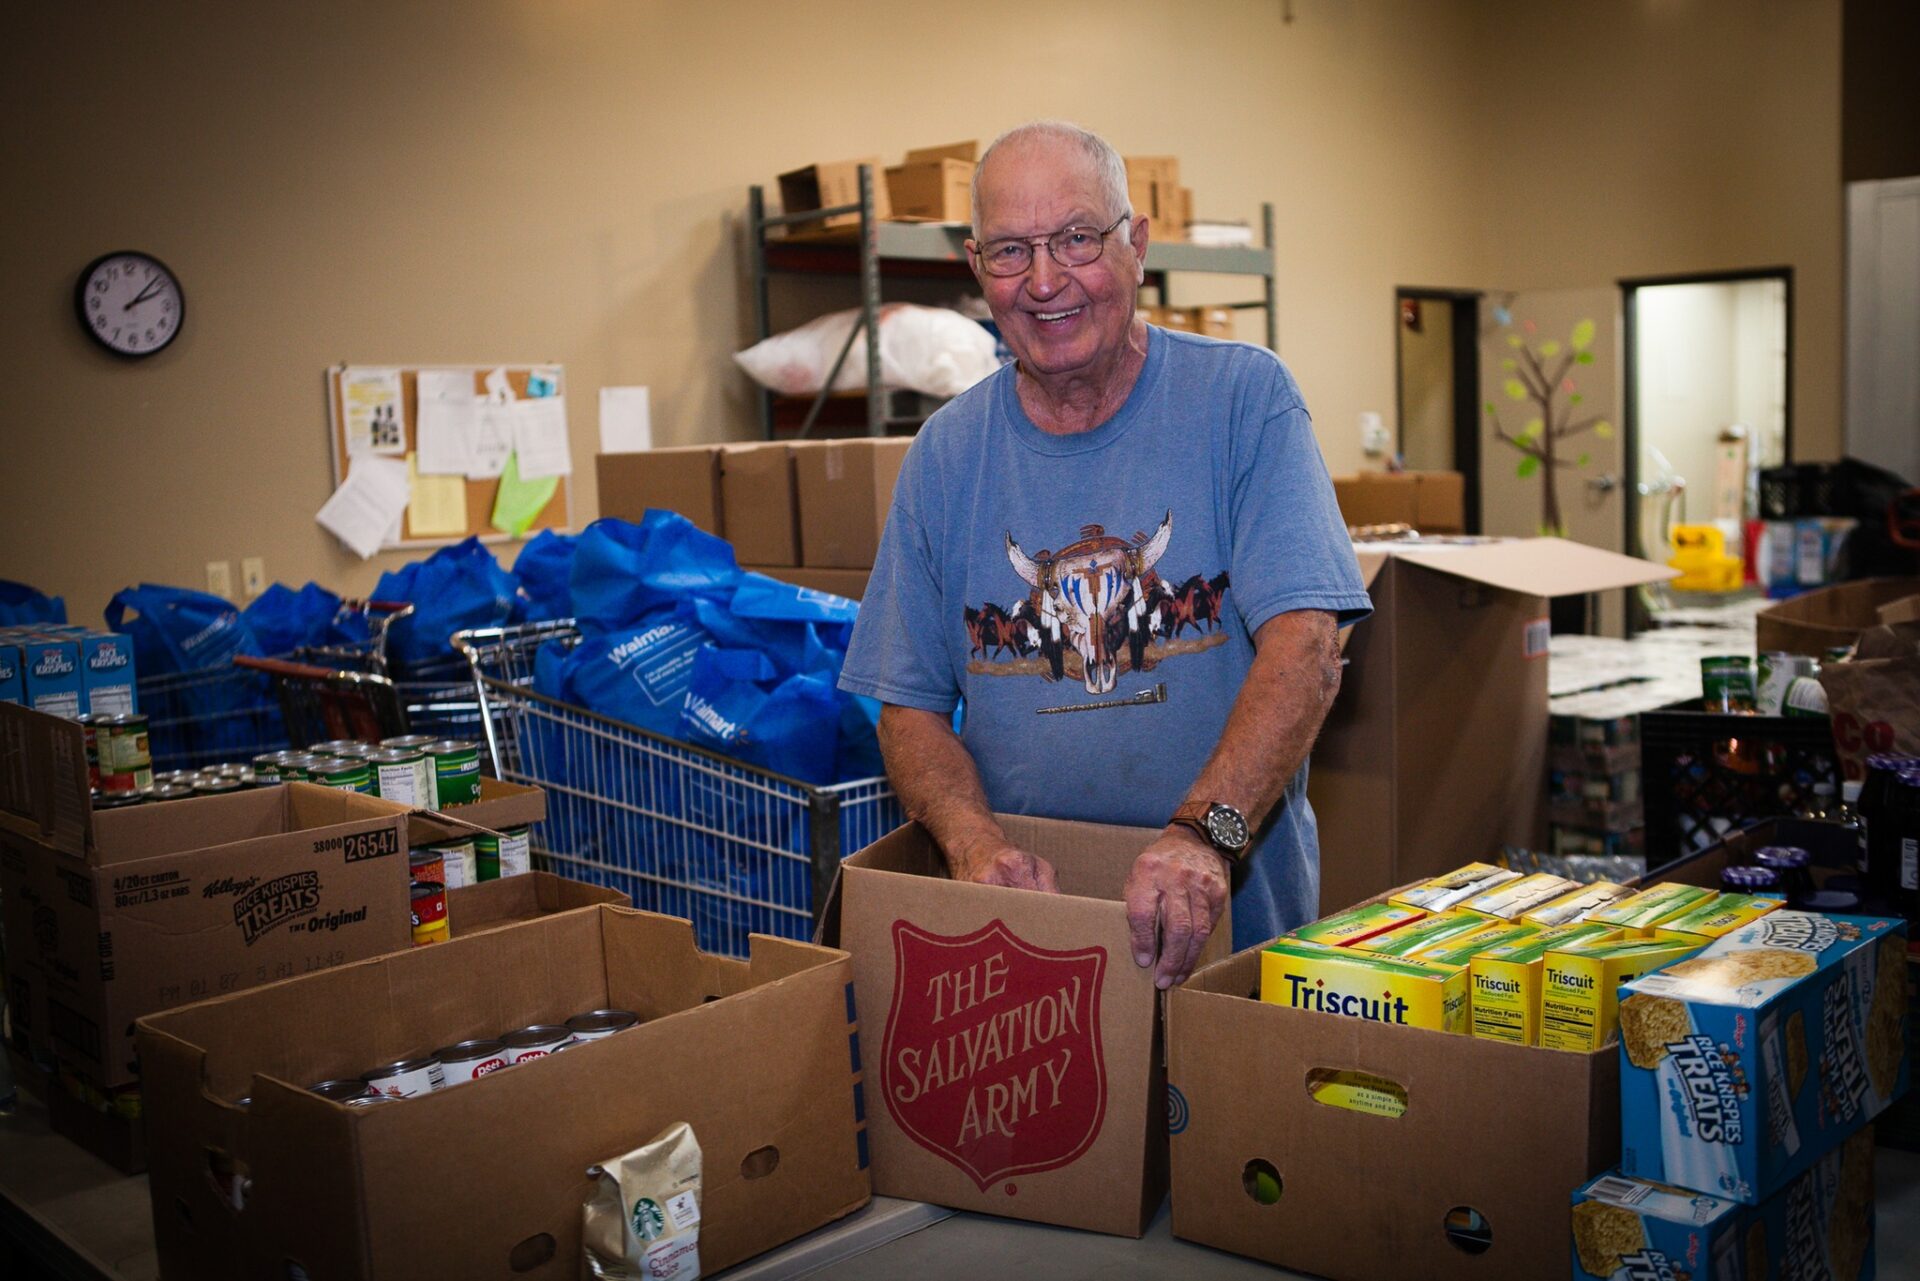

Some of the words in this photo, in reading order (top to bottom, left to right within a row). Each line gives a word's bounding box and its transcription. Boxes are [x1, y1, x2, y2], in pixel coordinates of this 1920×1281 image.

[44, 654, 62, 665] RICE
[98, 647, 117, 659] RICE
[608, 625, 675, 664] Walma
[35, 661, 74, 676] KRISPIES
[90, 655, 128, 669] KRISPIES
[684, 692, 736, 740] Walmart
[313, 838, 342, 853] 38000
[346, 830, 397, 861] 26547
[203, 877, 257, 898] Kellogg's
[235, 891, 261, 916] RICE
[260, 871, 318, 899] KRISPIES
[237, 887, 320, 946] TREATS
[308, 905, 367, 933] Original
[927, 952, 1010, 1024] THE
[1473, 974, 1520, 993] Triscuit
[1546, 968, 1594, 989] Triscuit
[1284, 974, 1408, 1025] Triscuit
[1474, 1007, 1503, 1016] Nutrition
[1504, 1011, 1522, 1019] Facts
[1545, 1002, 1573, 1011] Nutrition
[1575, 1008, 1593, 1016] Facts
[895, 976, 1081, 1103] SALVATION
[1833, 972, 1869, 1111] TREATS
[955, 1049, 1072, 1147] ARMY
[1664, 1035, 1726, 1144] TREATS
[1696, 1035, 1723, 1074] RICE
[1713, 1069, 1742, 1145] KRISPIES
[1648, 1251, 1677, 1281] RIC
